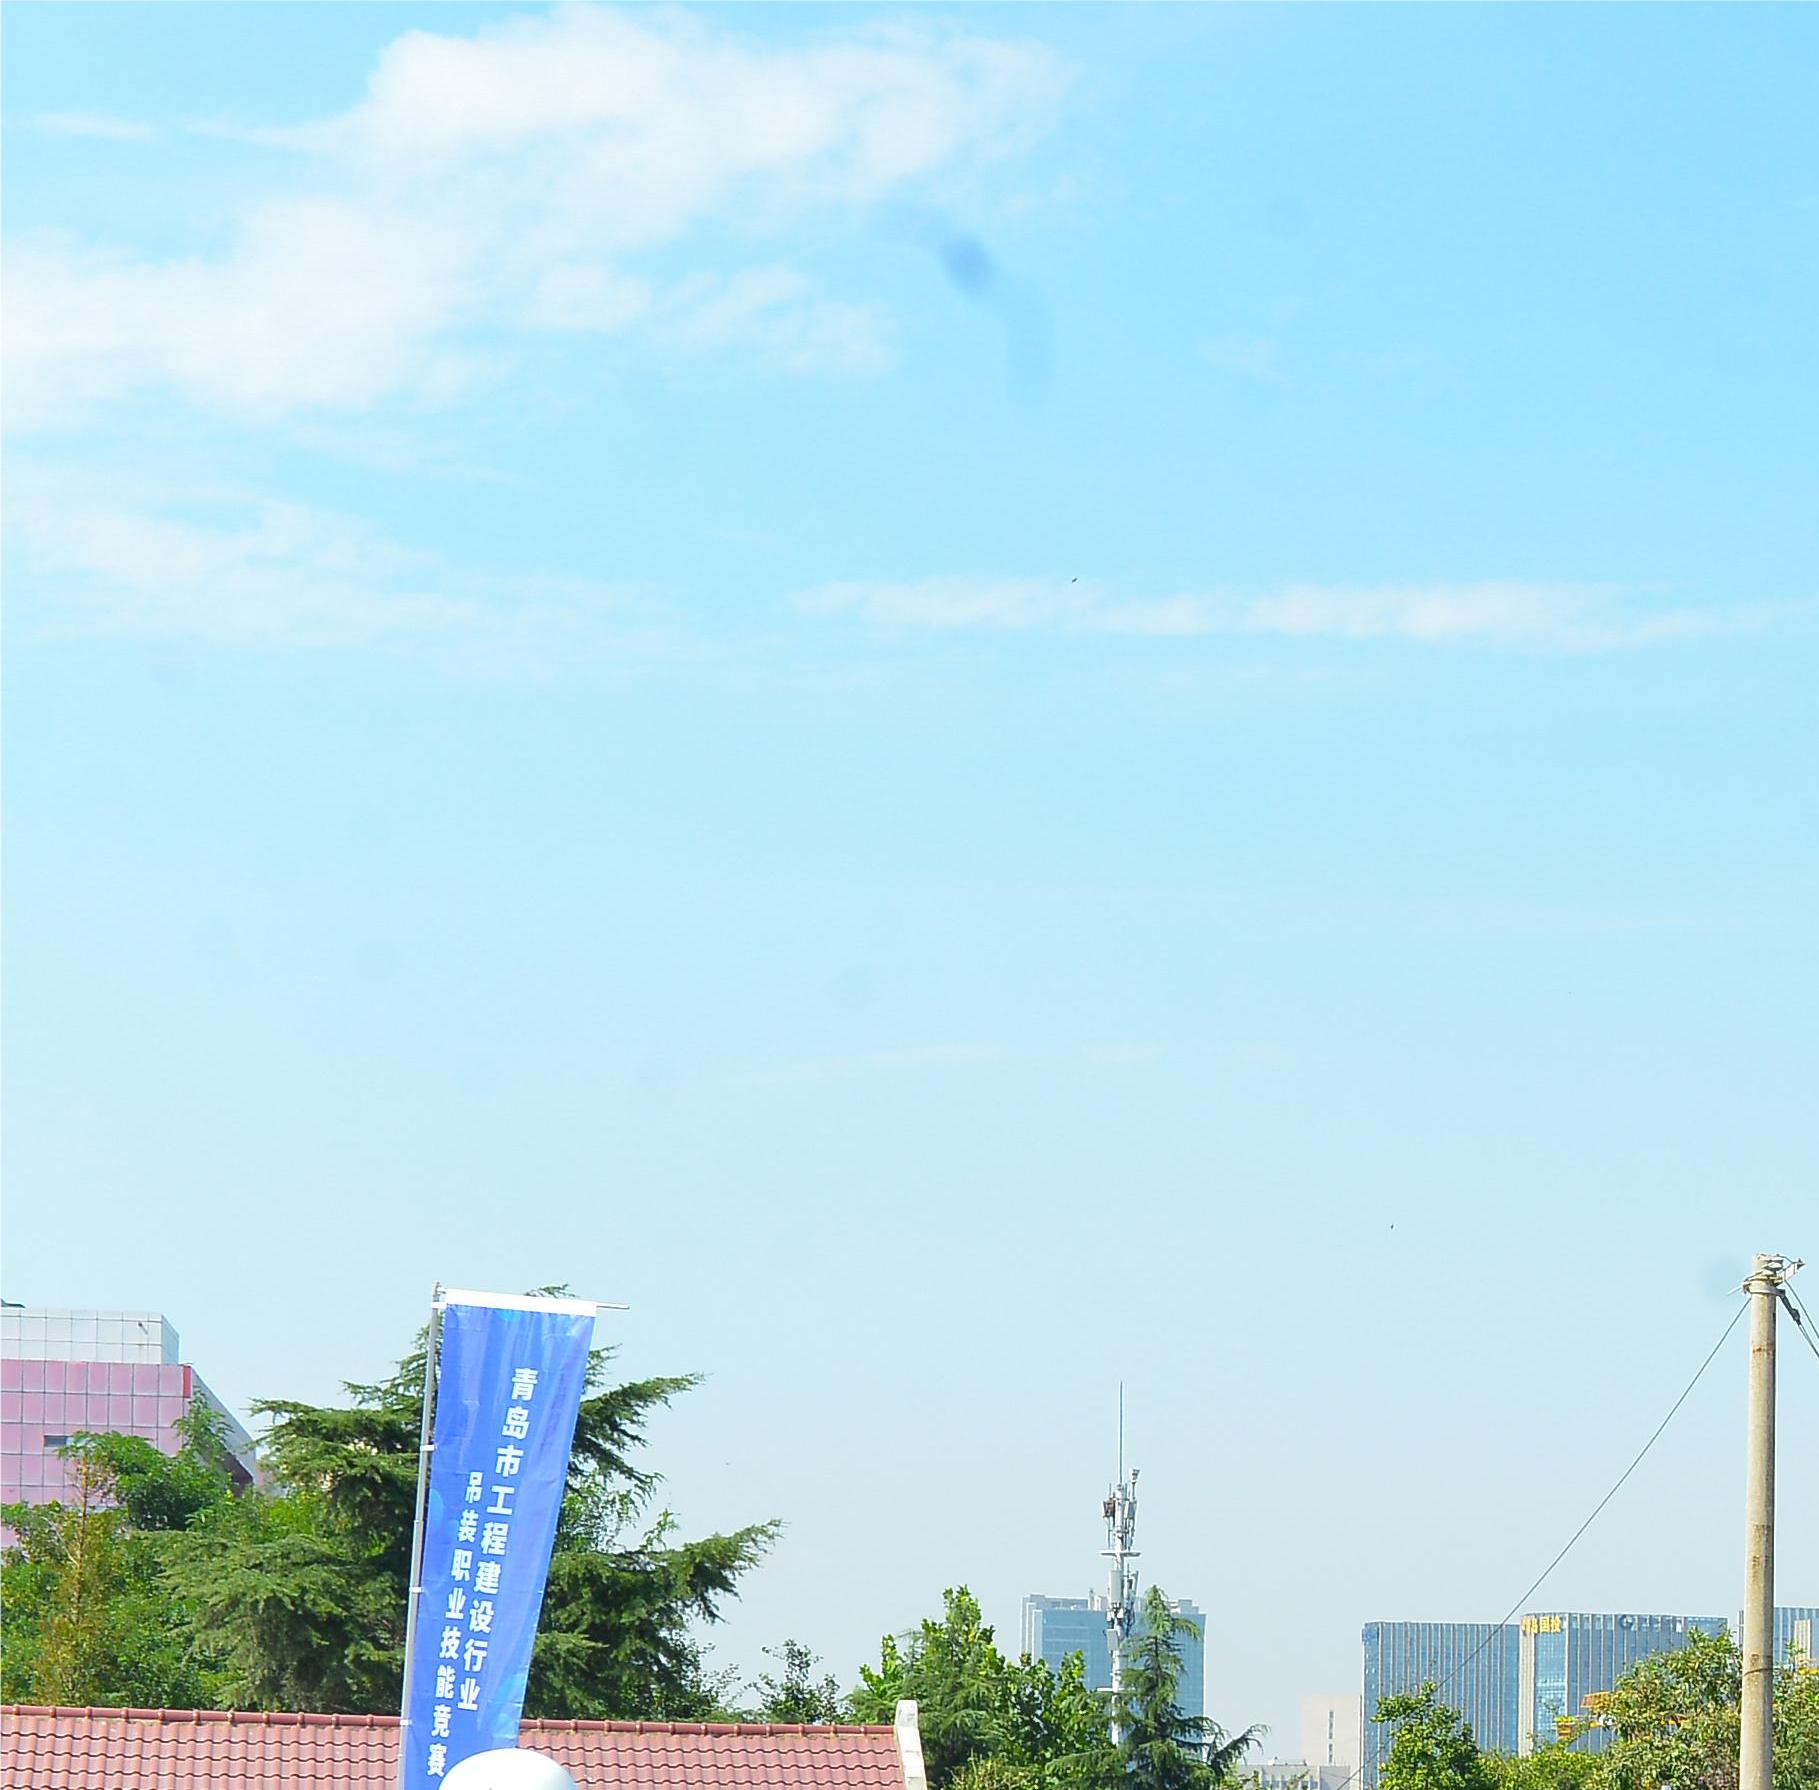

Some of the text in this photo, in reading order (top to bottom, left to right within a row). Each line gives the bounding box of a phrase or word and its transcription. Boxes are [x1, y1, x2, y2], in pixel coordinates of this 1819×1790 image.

[427, 1471, 484, 1778] 吊装职业技能竞赛
[457, 1367, 539, 1712] 青岛市工程建设行业
